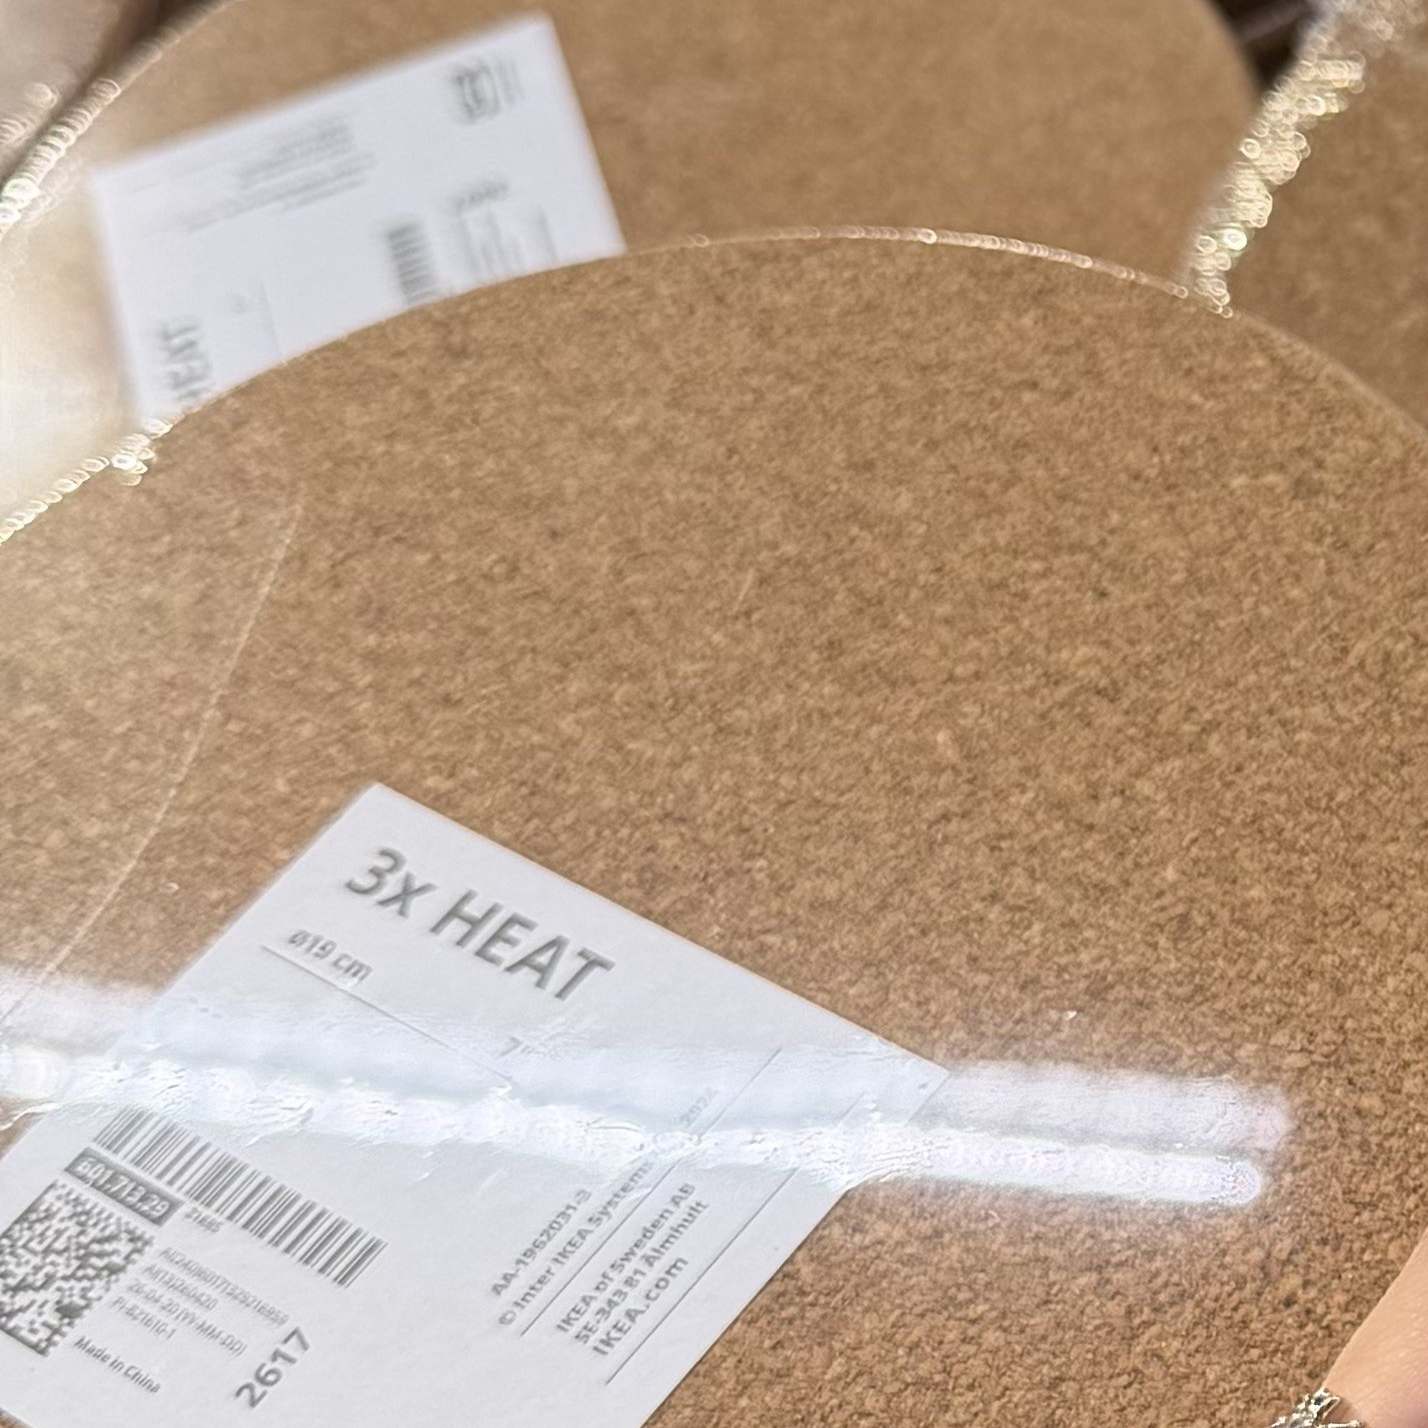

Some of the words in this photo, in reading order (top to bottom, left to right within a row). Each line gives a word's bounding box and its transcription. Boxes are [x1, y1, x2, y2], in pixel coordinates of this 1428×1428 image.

[345, 847, 437, 919] 3x
[430, 889, 616, 1001] HEAT
[332, 953, 373, 982] cm
[74, 1154, 171, 1220] 601.713.29
[512, 1269, 558, 1310] Inter
[555, 1228, 592, 1267] IKEA
[556, 1290, 598, 1334] IKEA
[595, 1272, 616, 1294] of
[609, 1208, 673, 1274] Sweden
[591, 1257, 690, 1357] IKEA.com
[574, 1285, 630, 1345] SE-343
[73, 1335, 112, 1365] Made
[107, 1355, 126, 1371] in
[122, 1363, 161, 1394] China
[234, 1326, 310, 1409] 2617
